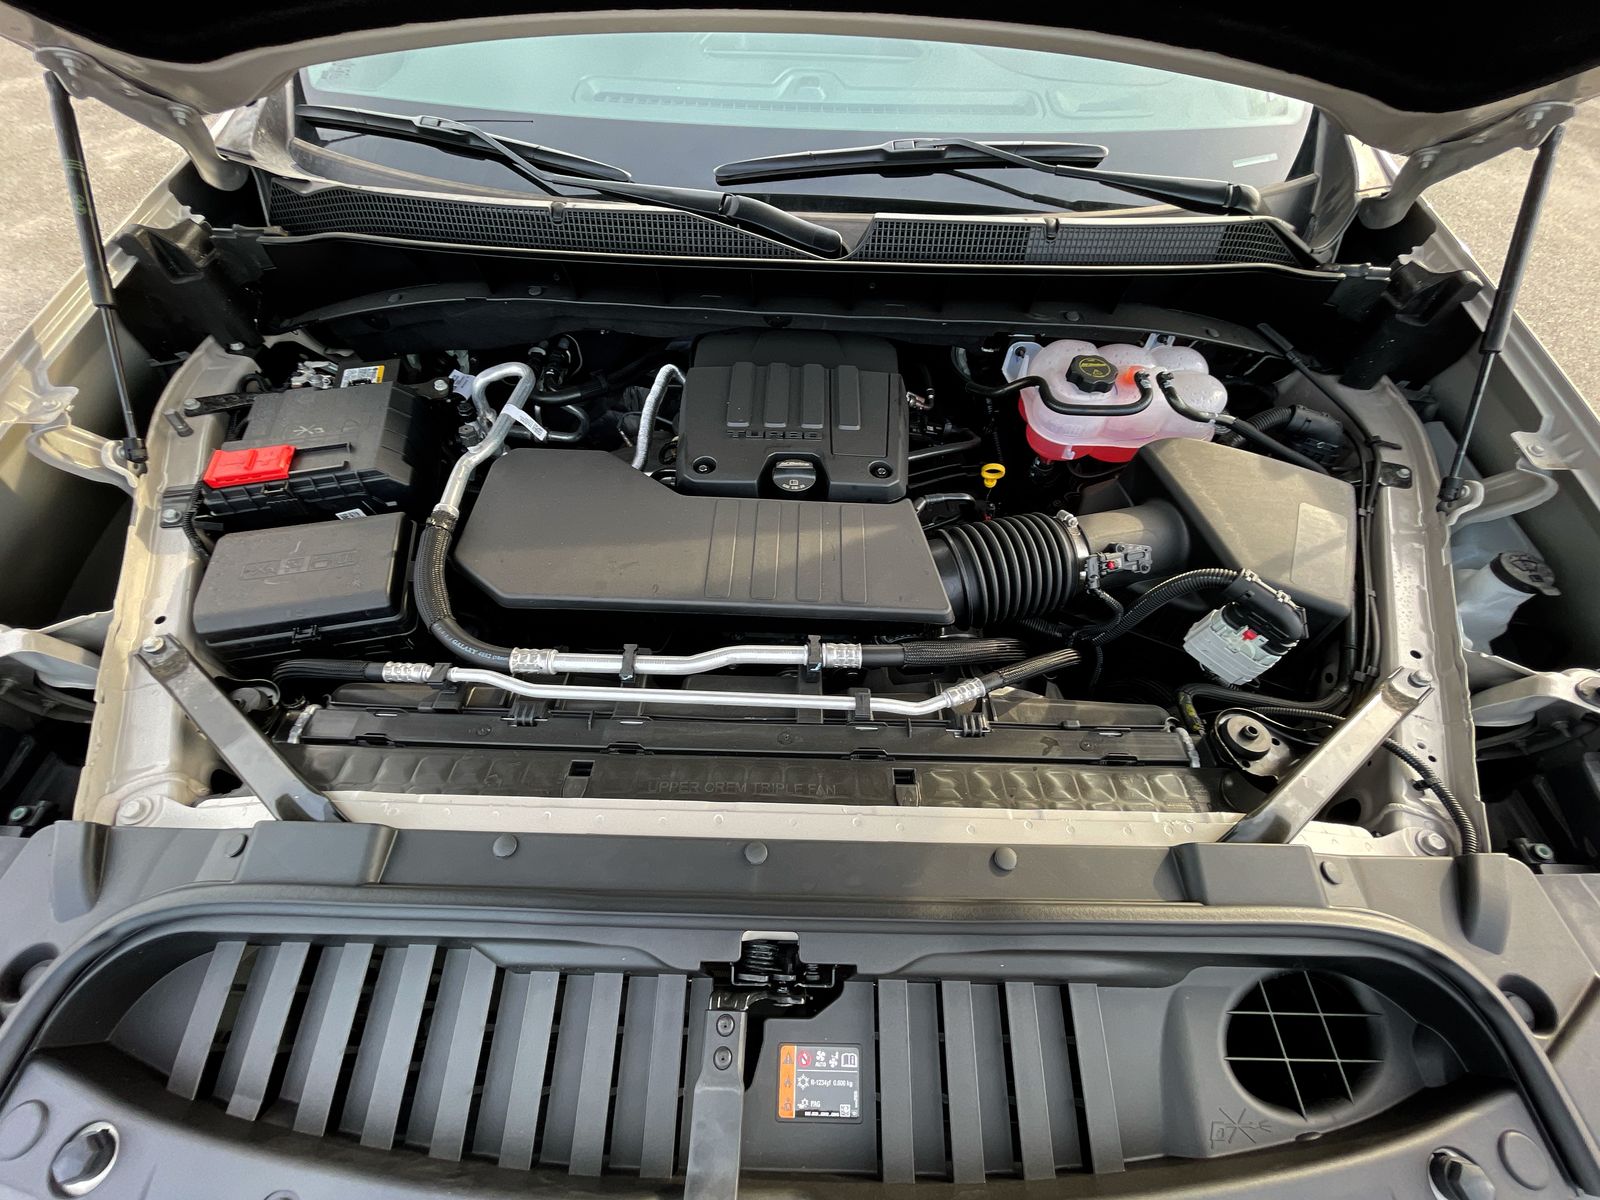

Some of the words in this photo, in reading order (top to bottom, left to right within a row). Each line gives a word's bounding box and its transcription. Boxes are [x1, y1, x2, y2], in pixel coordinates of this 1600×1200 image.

[648, 781, 700, 793] UPPER
[752, 782, 803, 794] TRIPLE
[808, 783, 836, 796] FAN
